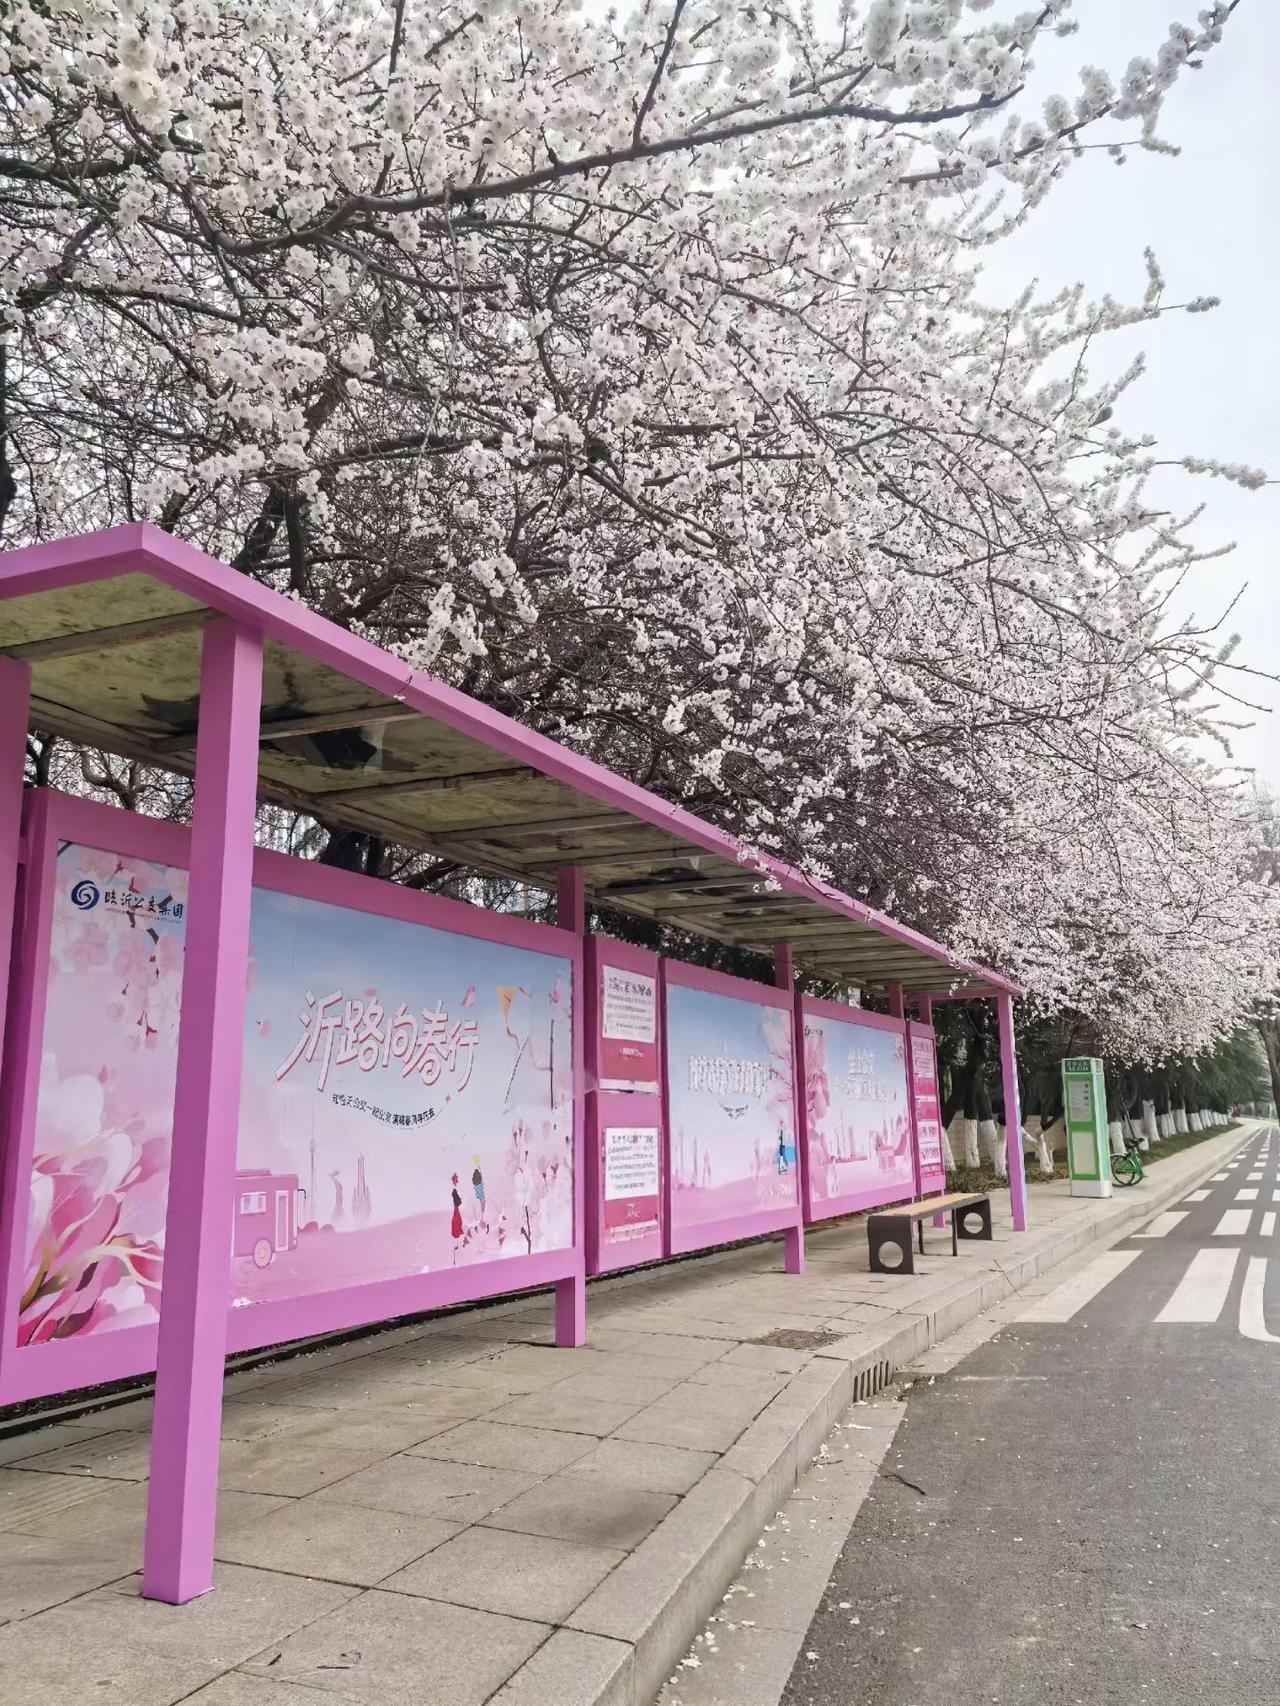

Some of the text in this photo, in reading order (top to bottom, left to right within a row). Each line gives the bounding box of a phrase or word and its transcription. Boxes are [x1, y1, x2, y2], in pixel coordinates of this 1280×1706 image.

[104, 890, 184, 919] 临沂公交集团
[274, 989, 480, 1092] 沂路向春行
